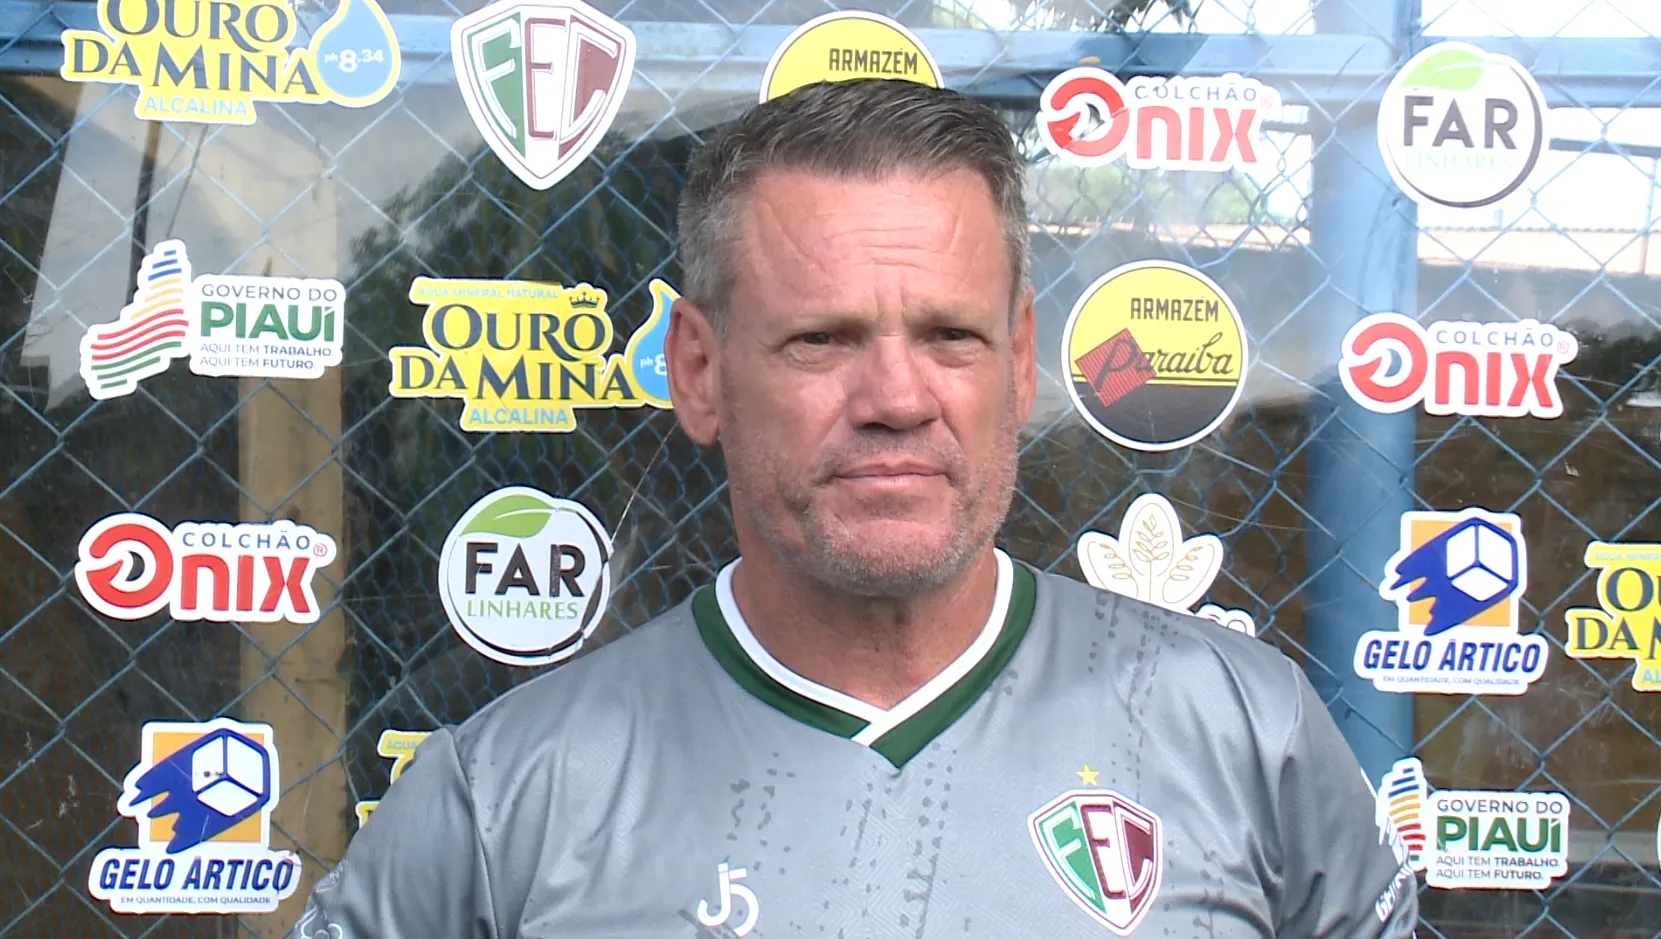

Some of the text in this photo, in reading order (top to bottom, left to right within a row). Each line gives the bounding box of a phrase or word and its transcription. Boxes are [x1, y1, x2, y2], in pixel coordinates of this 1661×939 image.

[106, 0, 289, 53] OURO
[72, 38, 320, 96] DA MINA
[339, 48, 384, 73] 8.34
[828, 48, 918, 75] ARMAZÉM
[472, 17, 618, 140] FEC
[1134, 83, 1257, 102] COLCHÃO
[144, 95, 248, 117] ALCALINA
[1403, 95, 1518, 150] FAR
[201, 284, 338, 302] GOVERNO DO
[201, 301, 335, 342] PIAUÍ
[1131, 297, 1219, 323] ARMAZÉM
[431, 304, 606, 362] OURO
[1436, 328, 1554, 347] COLCHÃO
[200, 343, 231, 354] AQUI
[236, 344, 260, 355] TEM
[200, 356, 230, 367] AQUI
[236, 357, 259, 367] TEM
[399, 355, 467, 390] DA
[472, 354, 637, 400] MINA
[469, 407, 569, 425] ALCALINA
[182, 530, 310, 550] COLCHÃO
[465, 541, 585, 597] FAR
[467, 599, 578, 620] LINHARES
[1575, 616, 1642, 651] DA
[1364, 639, 1432, 671] GELO
[1437, 799, 1563, 814] GOVERNO DO
[1437, 816, 1561, 853] PIAUÍ
[1042, 803, 1152, 900] FEC
[1436, 856, 1465, 866] AQUI
[1468, 857, 1491, 866] TEM
[100, 858, 175, 890] GELO
[1436, 869, 1464, 879] AQUI
[1468, 870, 1491, 878] TEM
[220, 897, 270, 905] QUALIDADE
